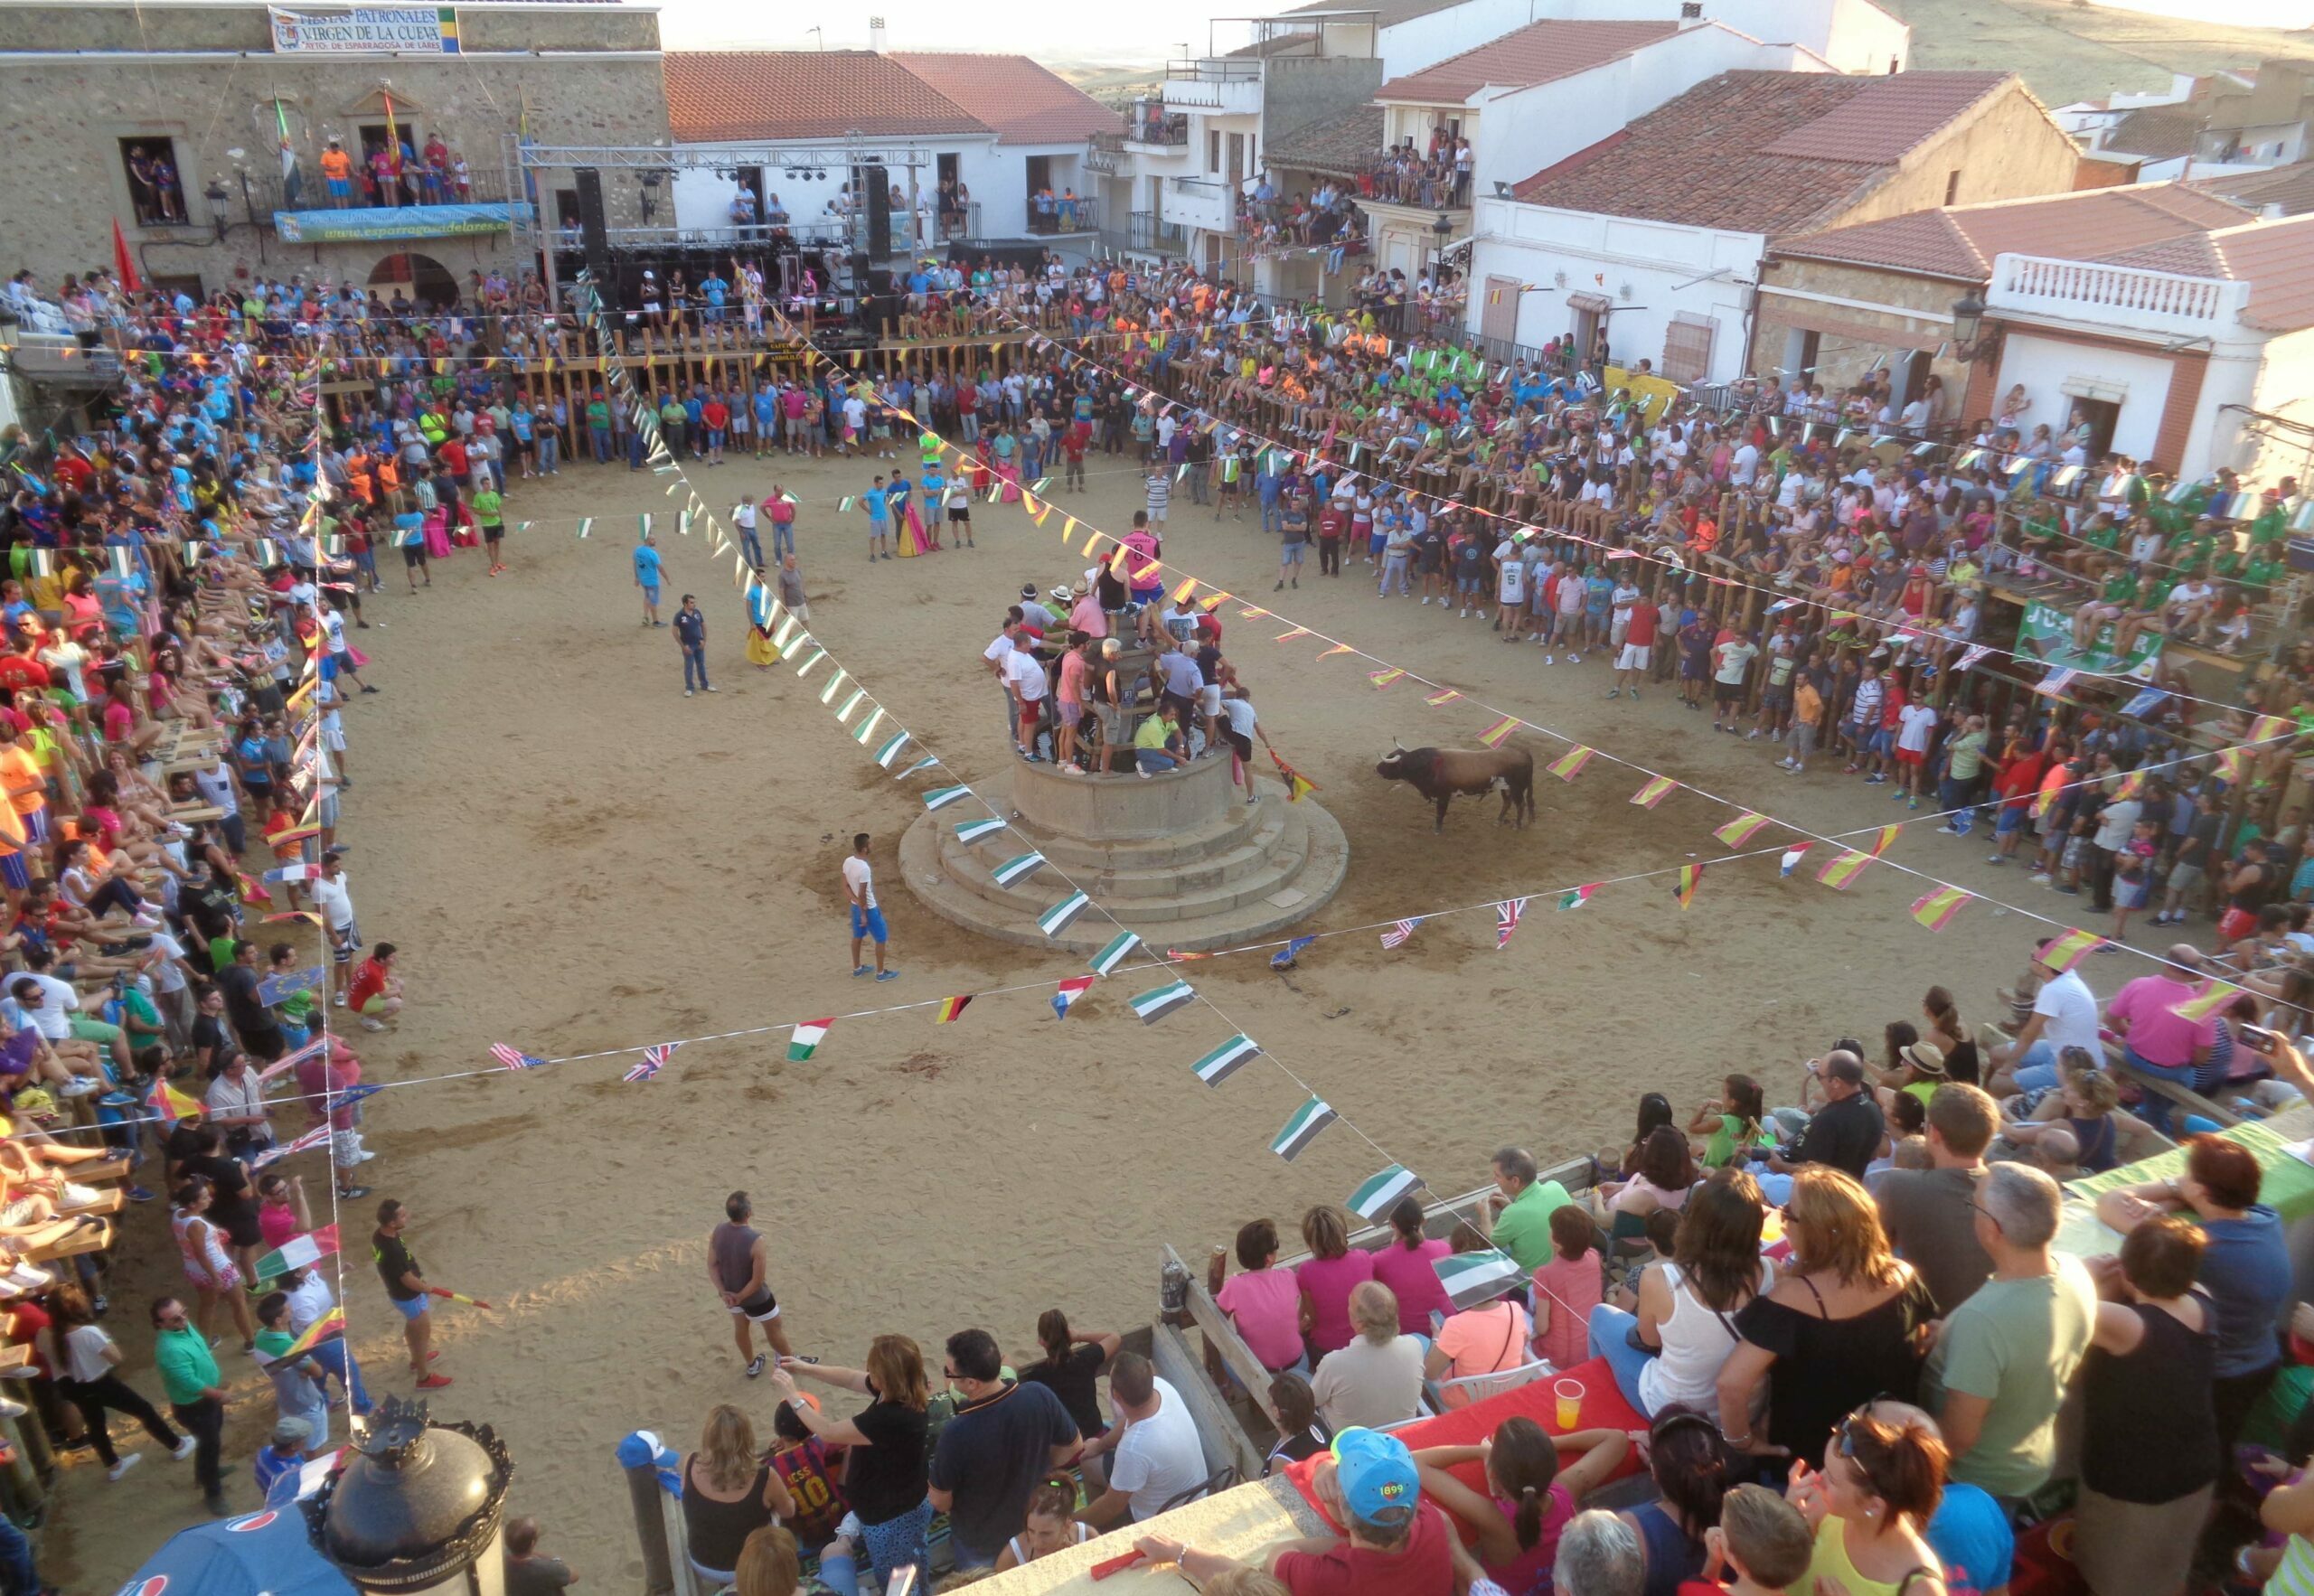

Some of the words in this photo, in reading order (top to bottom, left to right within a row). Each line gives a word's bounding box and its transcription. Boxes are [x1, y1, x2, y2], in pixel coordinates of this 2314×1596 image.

[355, 10, 437, 23] PATRONALES
[302, 26, 353, 41] VIRGEN
[355, 26, 373, 41] DE
[376, 25, 392, 40] LA
[398, 26, 439, 40] CUEVA
[331, 42, 342, 50] DE
[345, 42, 400, 50] ESPARRAGOSA
[405, 42, 415, 50] DE
[418, 41, 440, 49] LARES
[325, 220, 511, 239] www.esparragosadelares.es
[1134, 543, 1143, 561] 8
[1508, 575, 1516, 585] 5
[787, 1476, 829, 1516] 10
[1380, 1484, 1404, 1496] 1899
